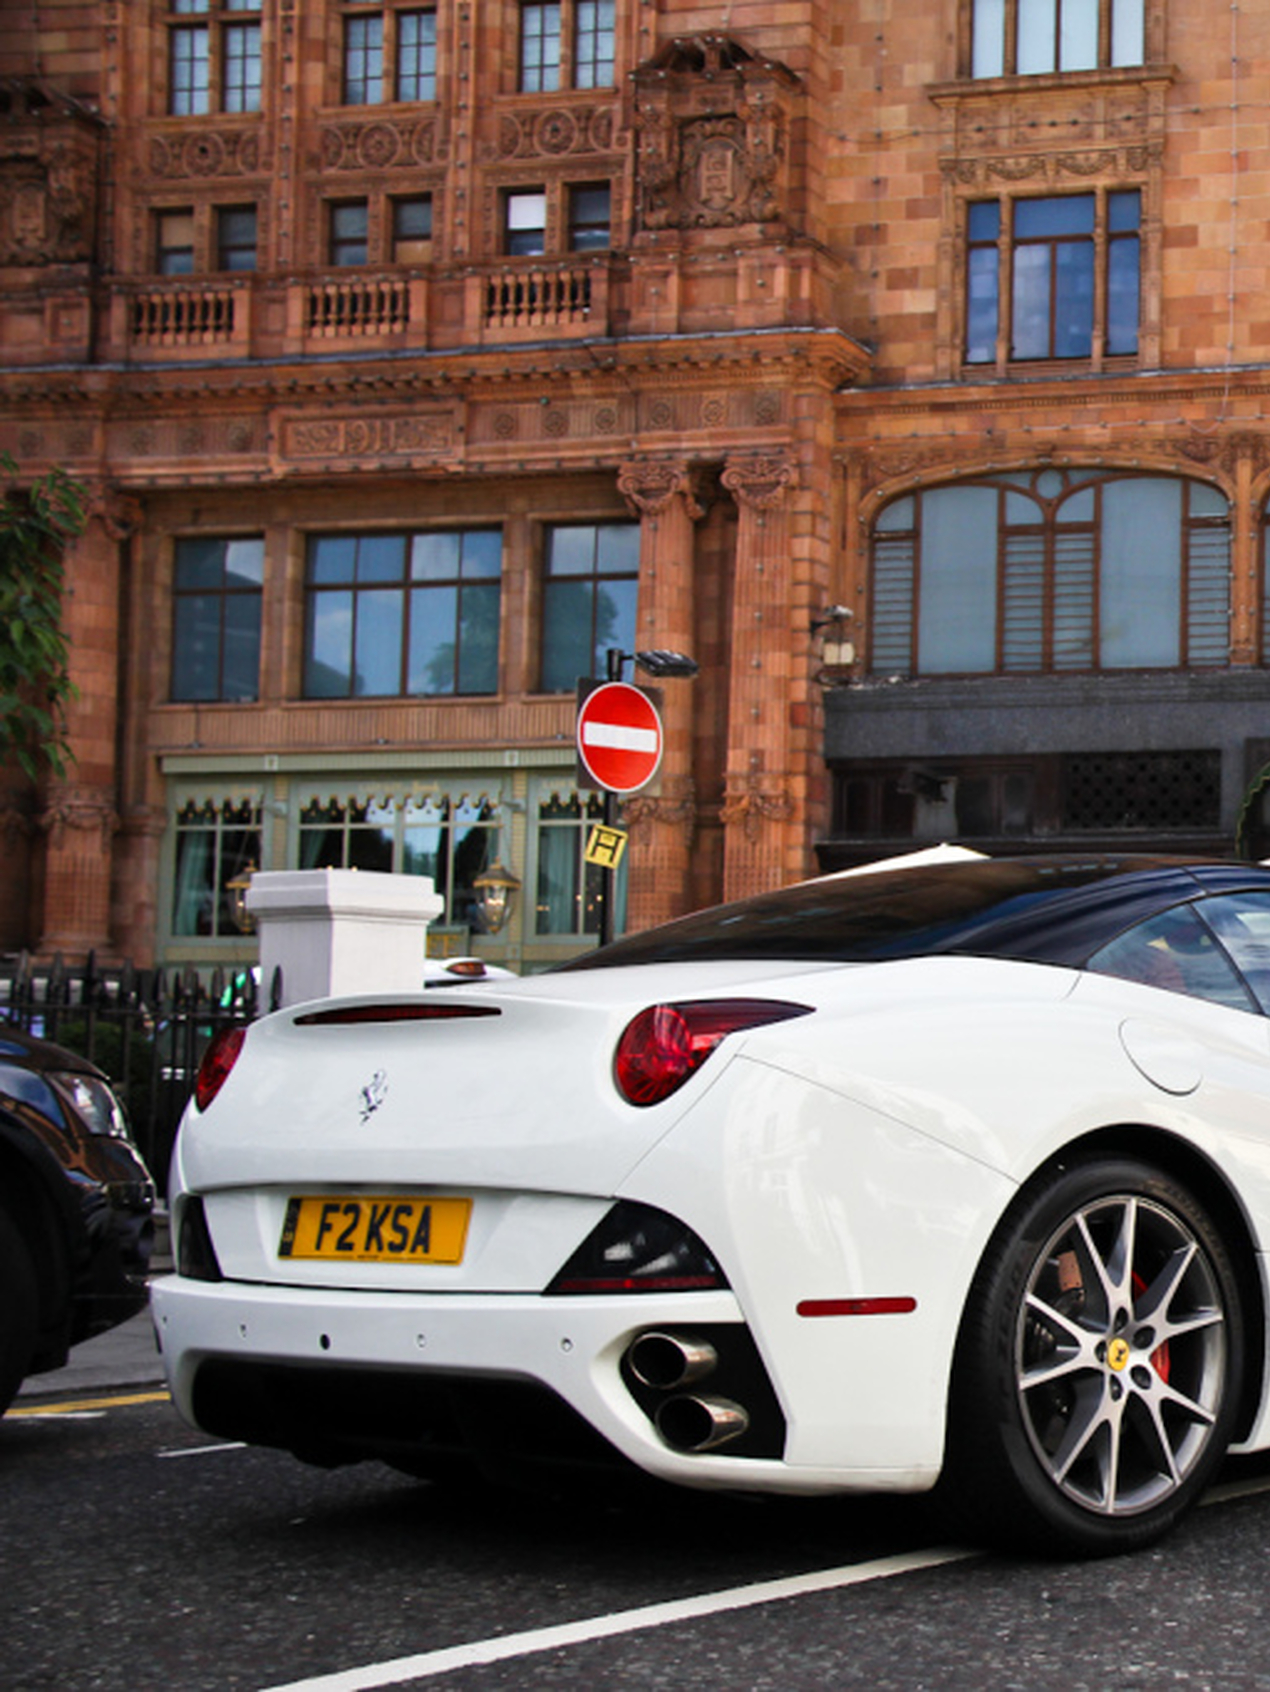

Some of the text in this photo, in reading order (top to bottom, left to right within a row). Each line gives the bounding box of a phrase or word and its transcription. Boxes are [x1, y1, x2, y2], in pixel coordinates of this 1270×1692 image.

[337, 420, 398, 453] 1911
[590, 829, 624, 863] H
[315, 1203, 362, 1252] F2
[363, 1203, 433, 1255] KSA
